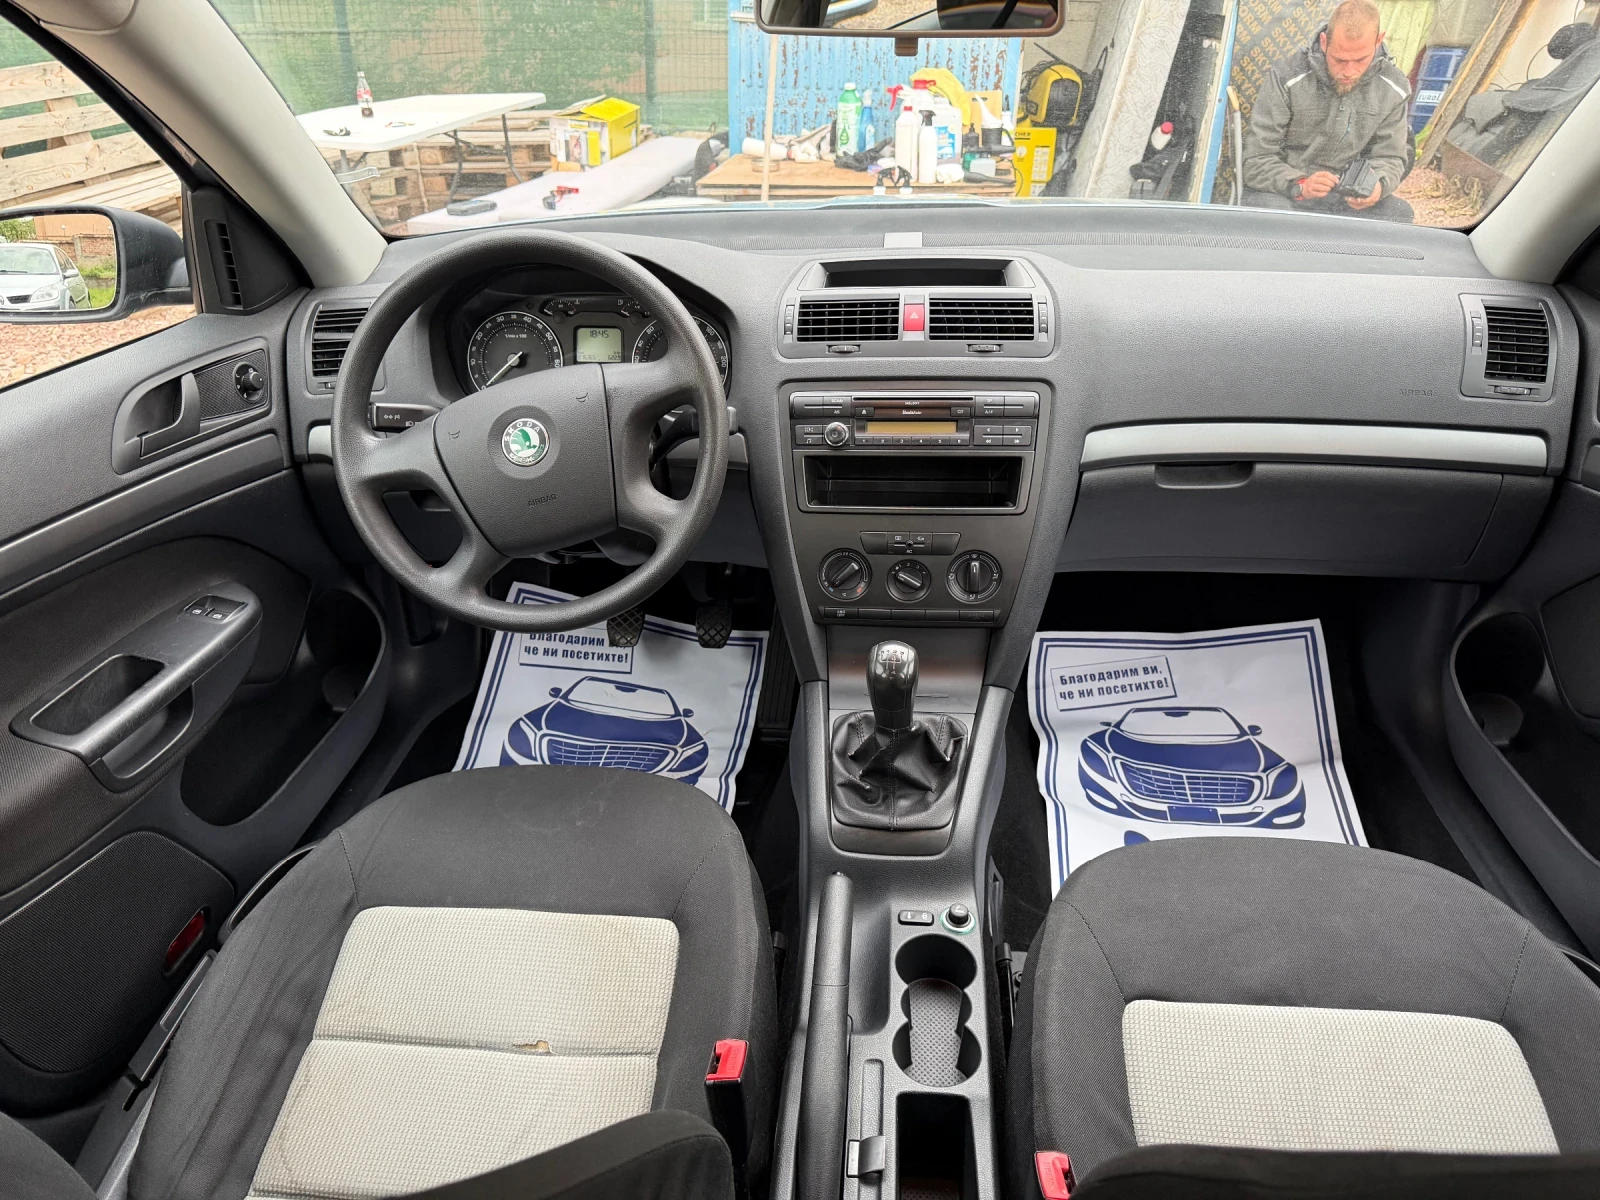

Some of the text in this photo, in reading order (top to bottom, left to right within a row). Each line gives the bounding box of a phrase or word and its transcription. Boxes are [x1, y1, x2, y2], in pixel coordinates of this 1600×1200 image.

[527, 493, 557, 507] AIRBAG
[524, 645, 629, 664] че ни посетихте!
[1060, 667, 1140, 686] Благодарим
[1059, 677, 1170, 700] че ни посетихте!
